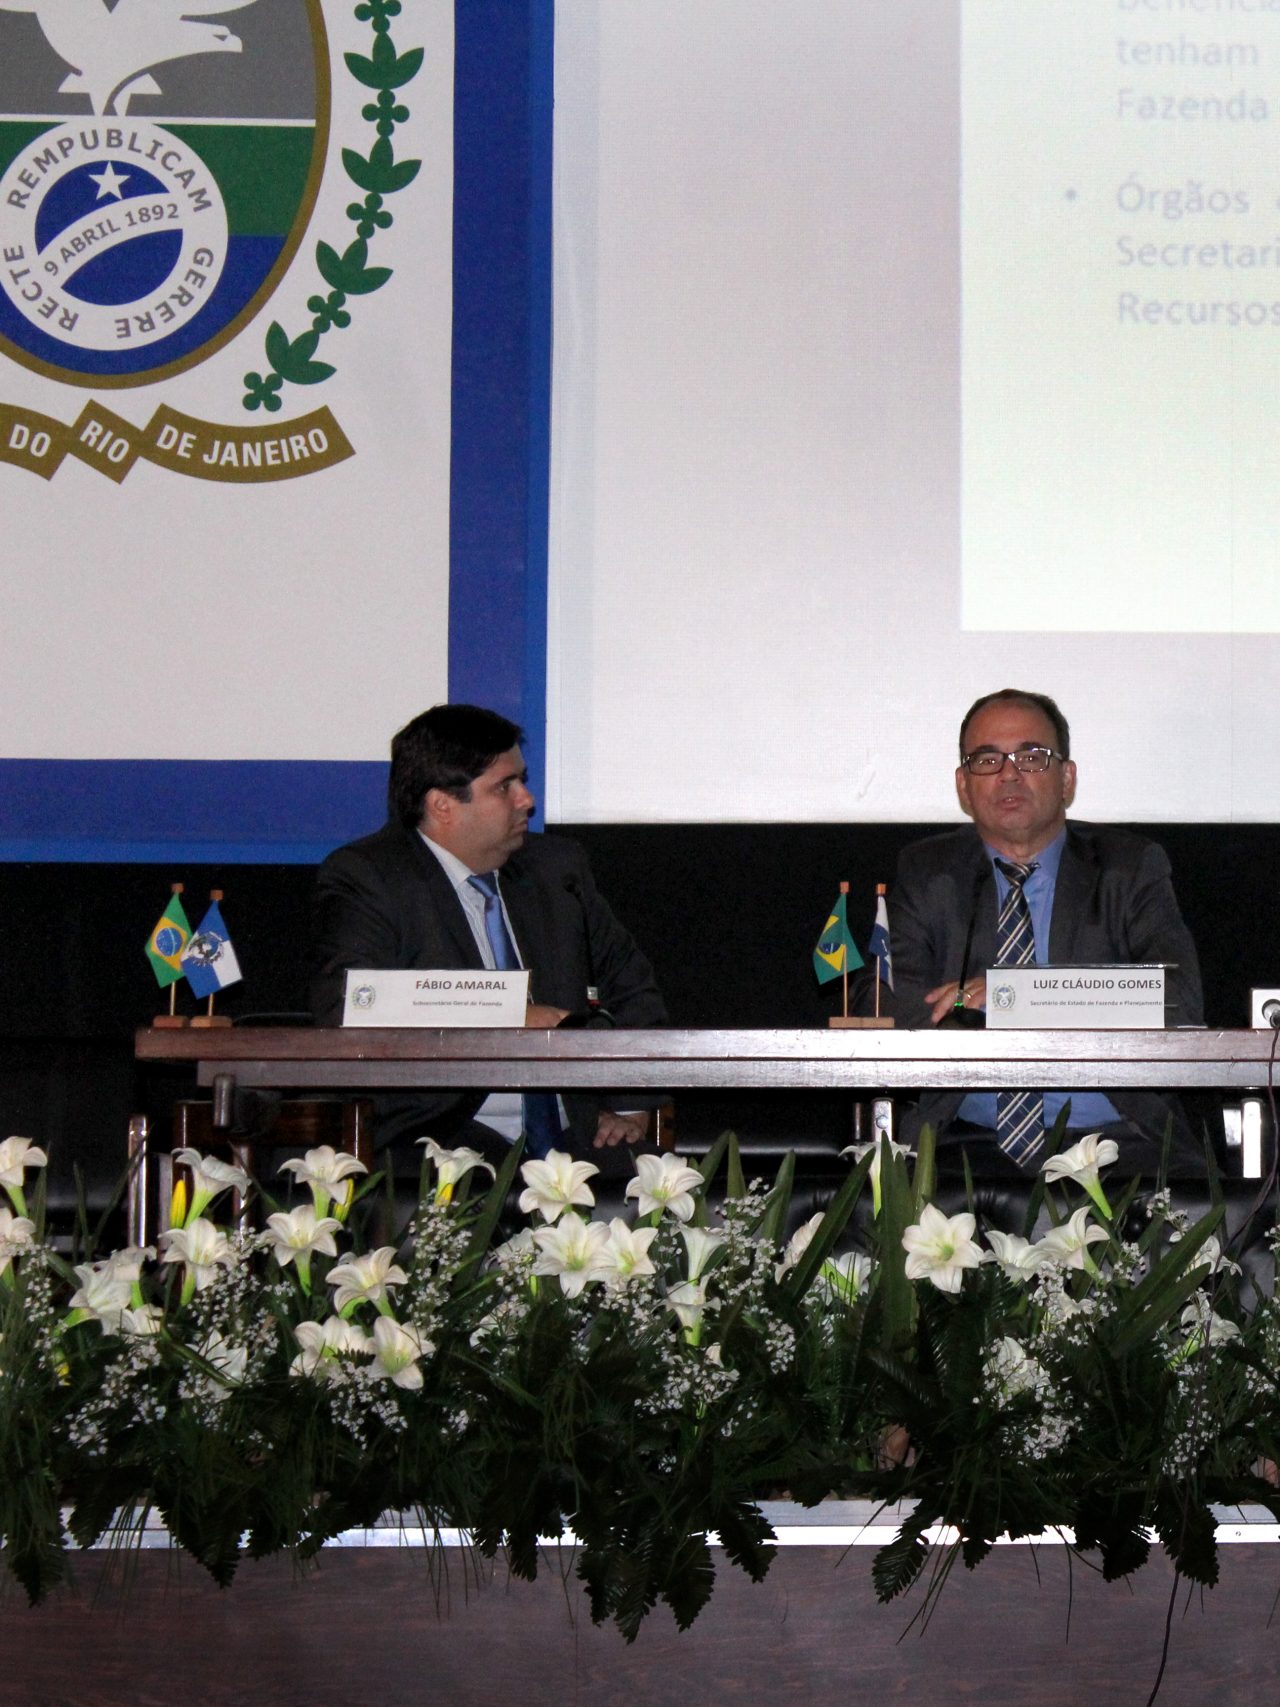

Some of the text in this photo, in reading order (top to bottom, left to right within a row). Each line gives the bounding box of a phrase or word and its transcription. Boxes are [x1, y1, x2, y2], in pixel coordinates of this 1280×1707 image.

[1116, 34, 1259, 66] tenham
[1116, 88, 1269, 121] Fazenda
[6, 128, 213, 213] REMPUBLICAM
[1115, 172, 1250, 220] Órgãos
[44, 203, 180, 277] 9 ABRIL 1892
[4, 244, 80, 332] RECTE
[115, 247, 214, 339] GERERE
[8, 420, 329, 468] DO RIO DE JANEIRO
[415, 978, 508, 990] FÁBIO AMARAL
[1033, 977, 1162, 989] LUIZ CLÁUDIO GOMES
